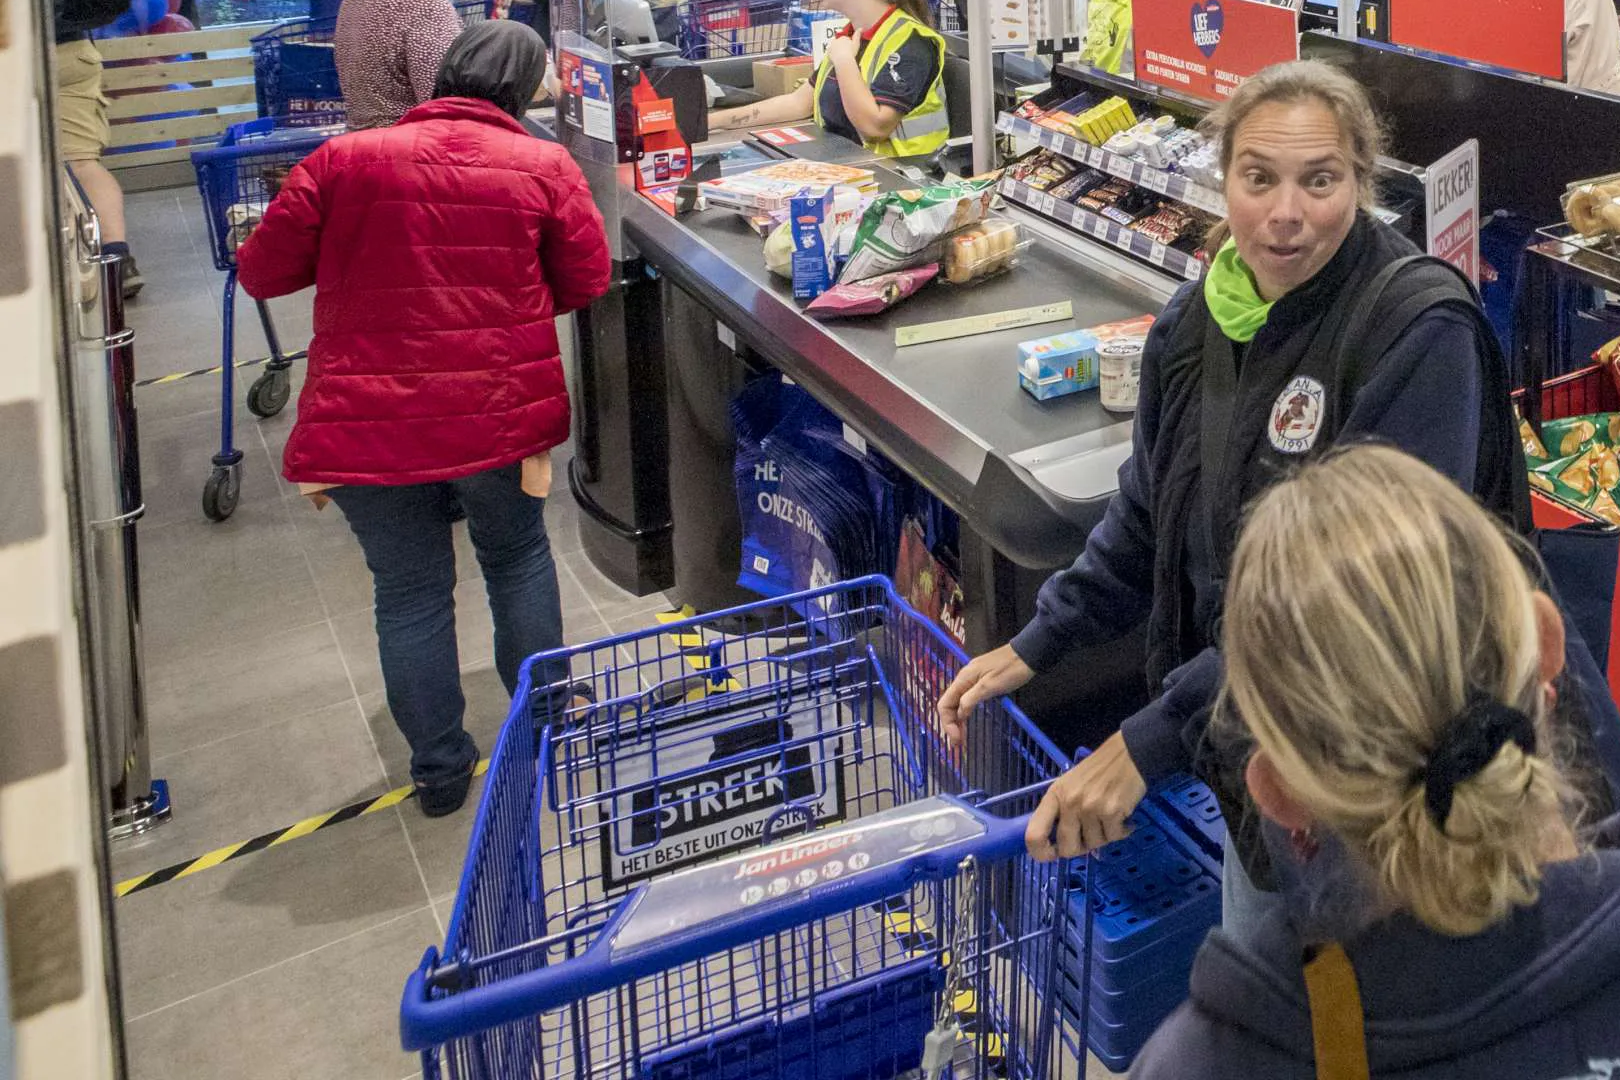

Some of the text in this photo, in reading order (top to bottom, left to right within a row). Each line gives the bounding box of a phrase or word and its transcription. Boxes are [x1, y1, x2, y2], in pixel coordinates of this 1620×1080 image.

[1194, 12, 1208, 32] LIEF
[1433, 157, 1474, 215] LEKKER!
[1283, 439, 1310, 452] 1991
[758, 491, 795, 524] ONZE
[654, 759, 786, 830] STREEK
[622, 853, 650, 876] HET
[655, 837, 702, 866] BESTE
[704, 828, 729, 850] UIT
[734, 854, 778, 880] Jan
[780, 834, 864, 866] Linders
